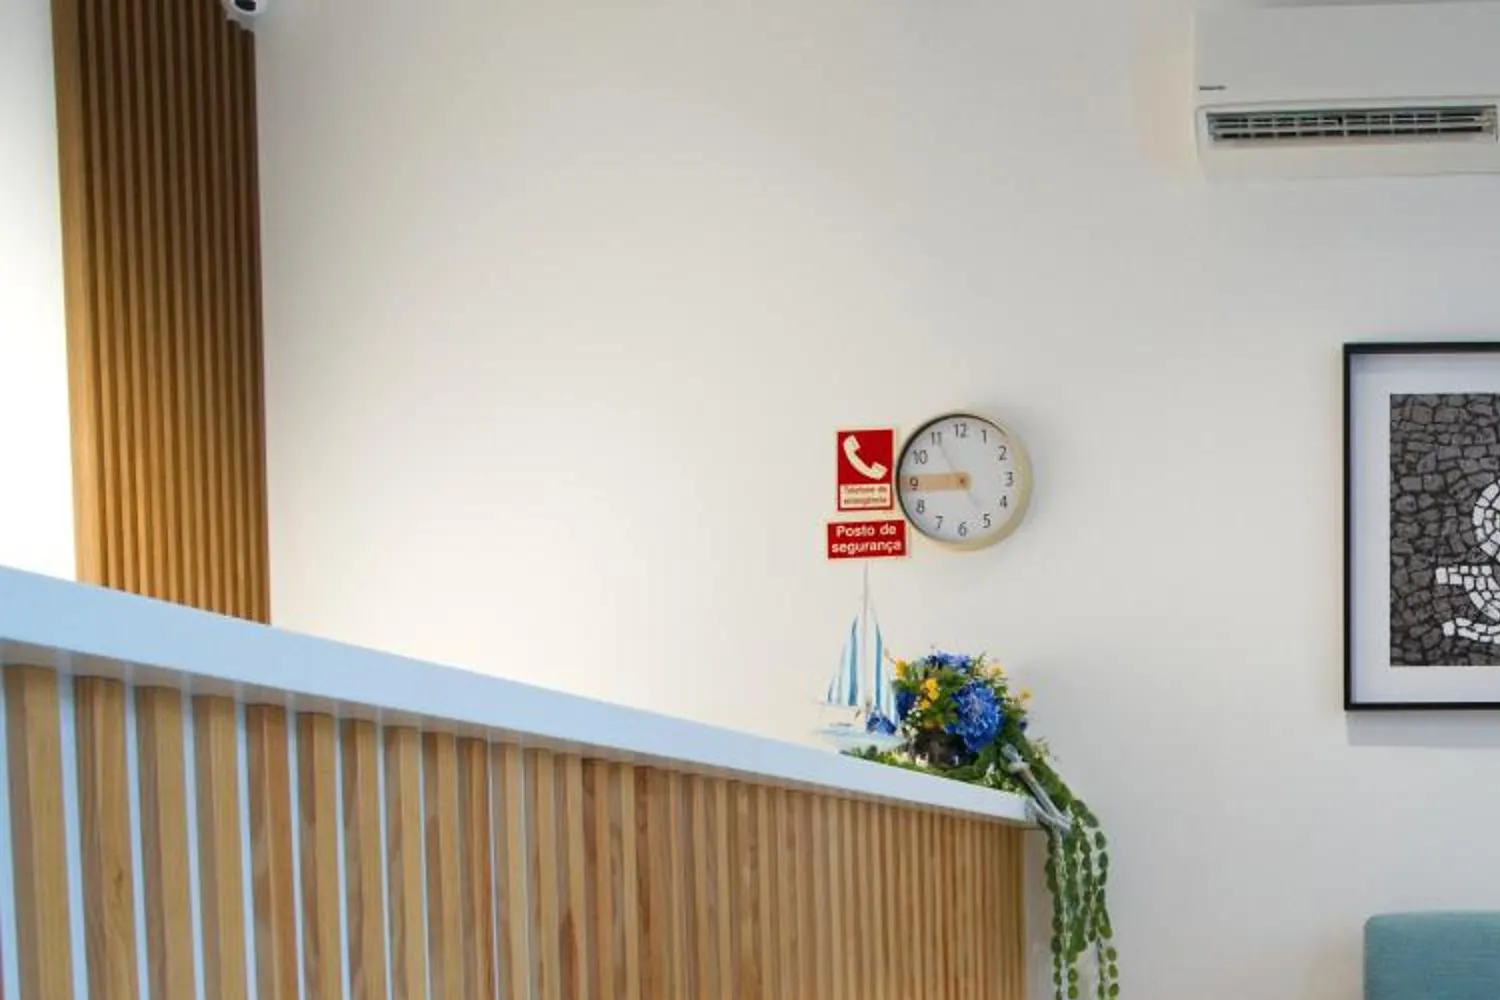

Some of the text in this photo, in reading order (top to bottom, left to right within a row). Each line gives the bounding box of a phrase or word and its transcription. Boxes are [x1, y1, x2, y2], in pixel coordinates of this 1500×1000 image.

[953, 423, 968, 438] 12
[981, 429, 988, 444] 1
[930, 431, 942, 446] 11
[913, 450, 928, 465] 10
[998, 445, 1008, 461] 2
[909, 477, 919, 490] 9
[1004, 471, 1013, 487] 3
[915, 499, 925, 514] 8
[999, 495, 1008, 509] 4
[935, 516, 943, 531] 7
[982, 512, 991, 528] 5
[835, 523, 897, 537] Posto de
[957, 522, 967, 537] 6
[832, 540, 902, 556] segurança
